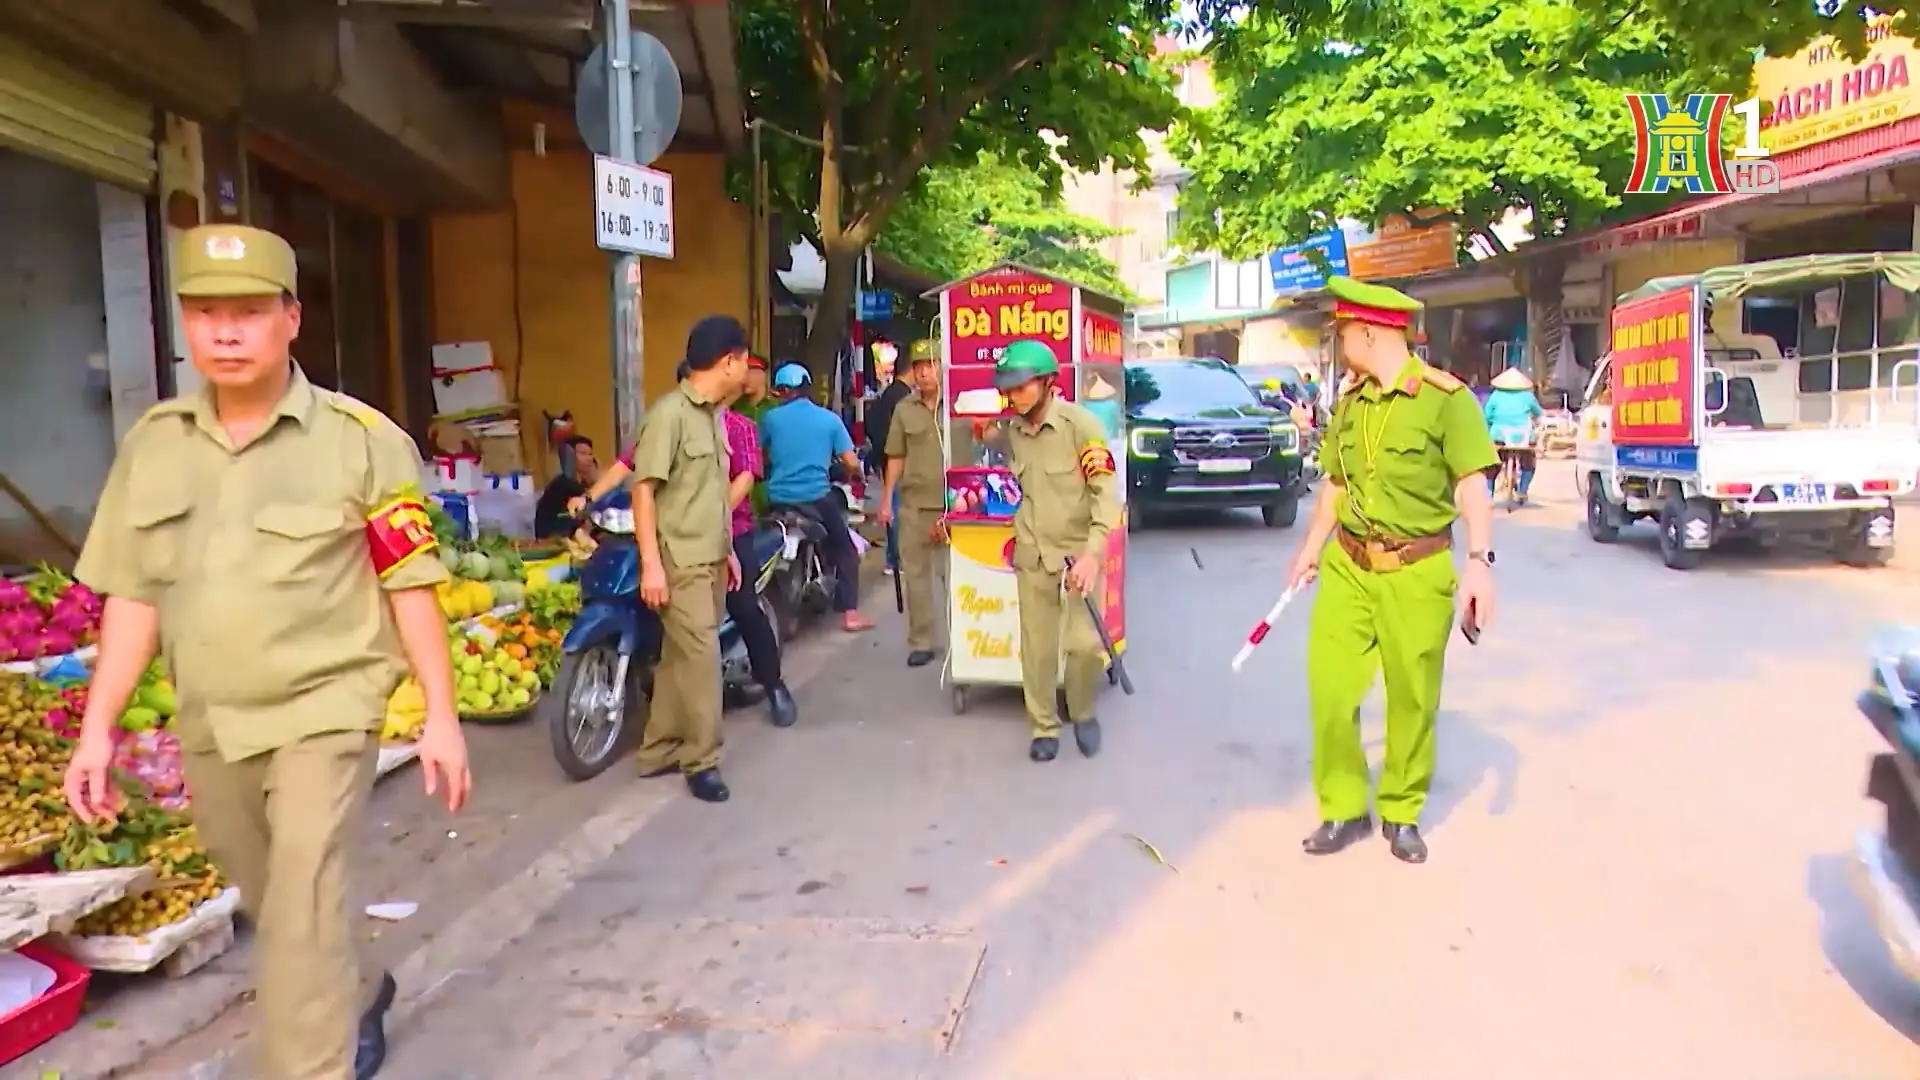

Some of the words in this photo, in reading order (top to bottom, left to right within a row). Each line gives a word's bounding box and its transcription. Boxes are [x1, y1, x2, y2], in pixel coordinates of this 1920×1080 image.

[1841, 53, 1910, 107] HÓA
[607, 173, 631, 199] 6:00
[601, 210, 632, 237] 16:00
[643, 219, 670, 243] 19:30
[969, 280, 1004, 299] Bánh
[954, 306, 992, 338] Đà
